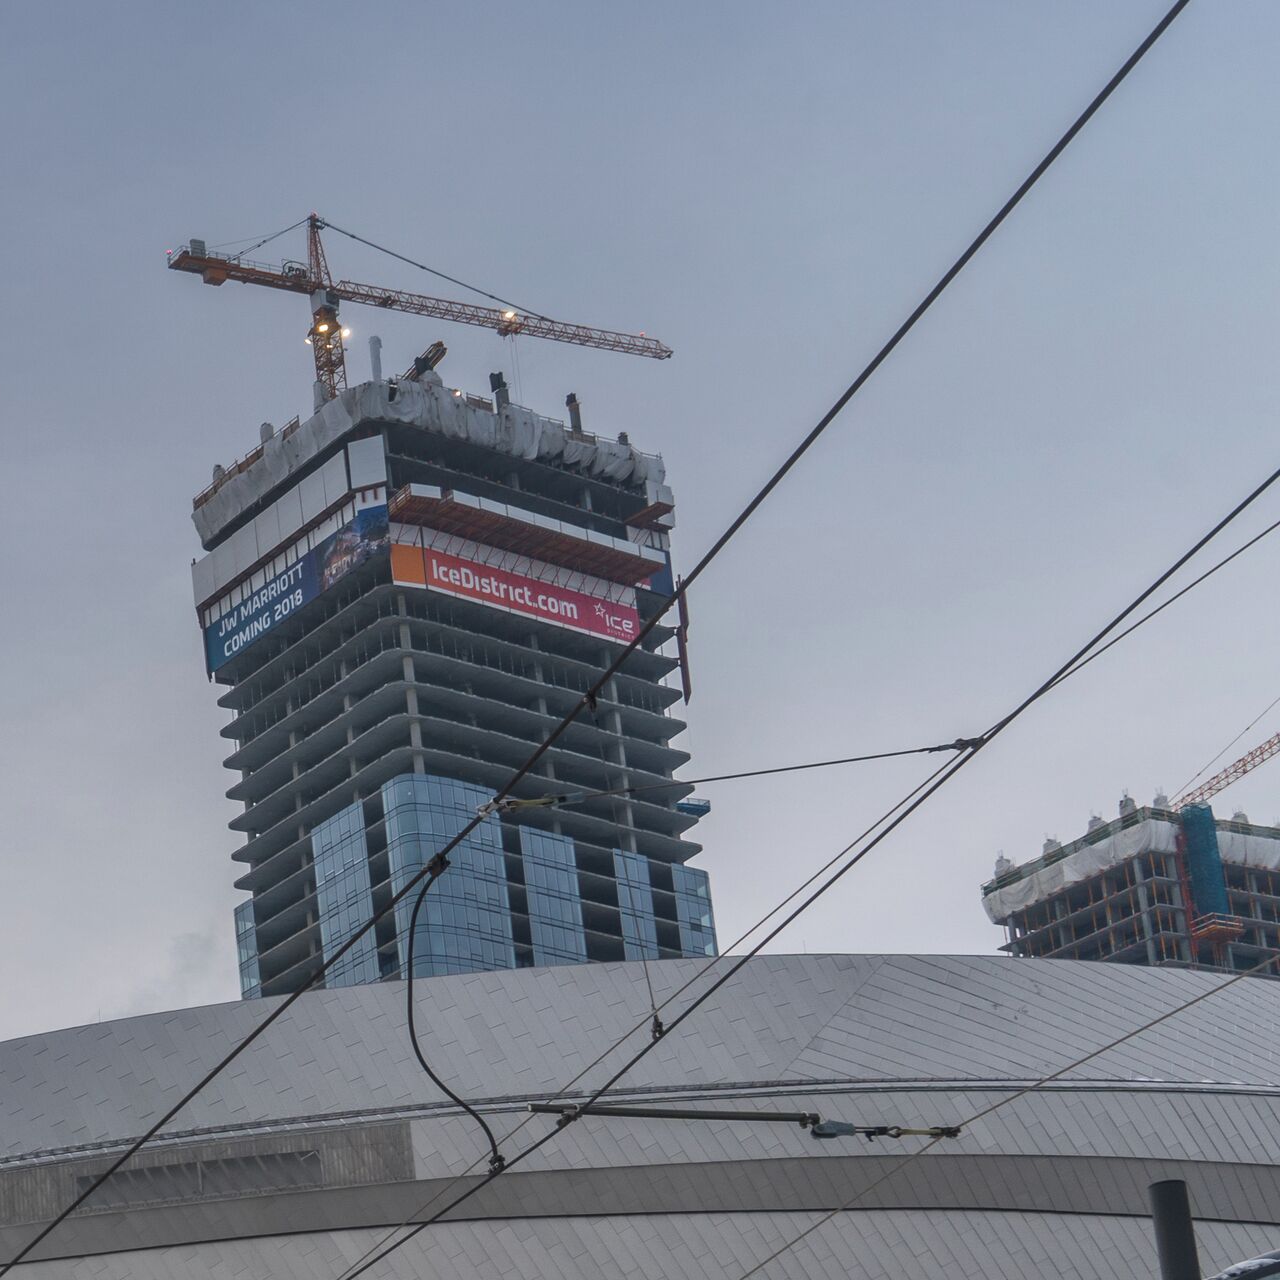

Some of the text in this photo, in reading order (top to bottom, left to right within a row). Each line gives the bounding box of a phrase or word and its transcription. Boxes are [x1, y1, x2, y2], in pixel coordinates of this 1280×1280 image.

[218, 611, 237, 637] JW
[240, 561, 304, 621] MARRIOTT
[224, 588, 304, 657] COMING 2018
[431, 558, 579, 620] IceDistrict.com
